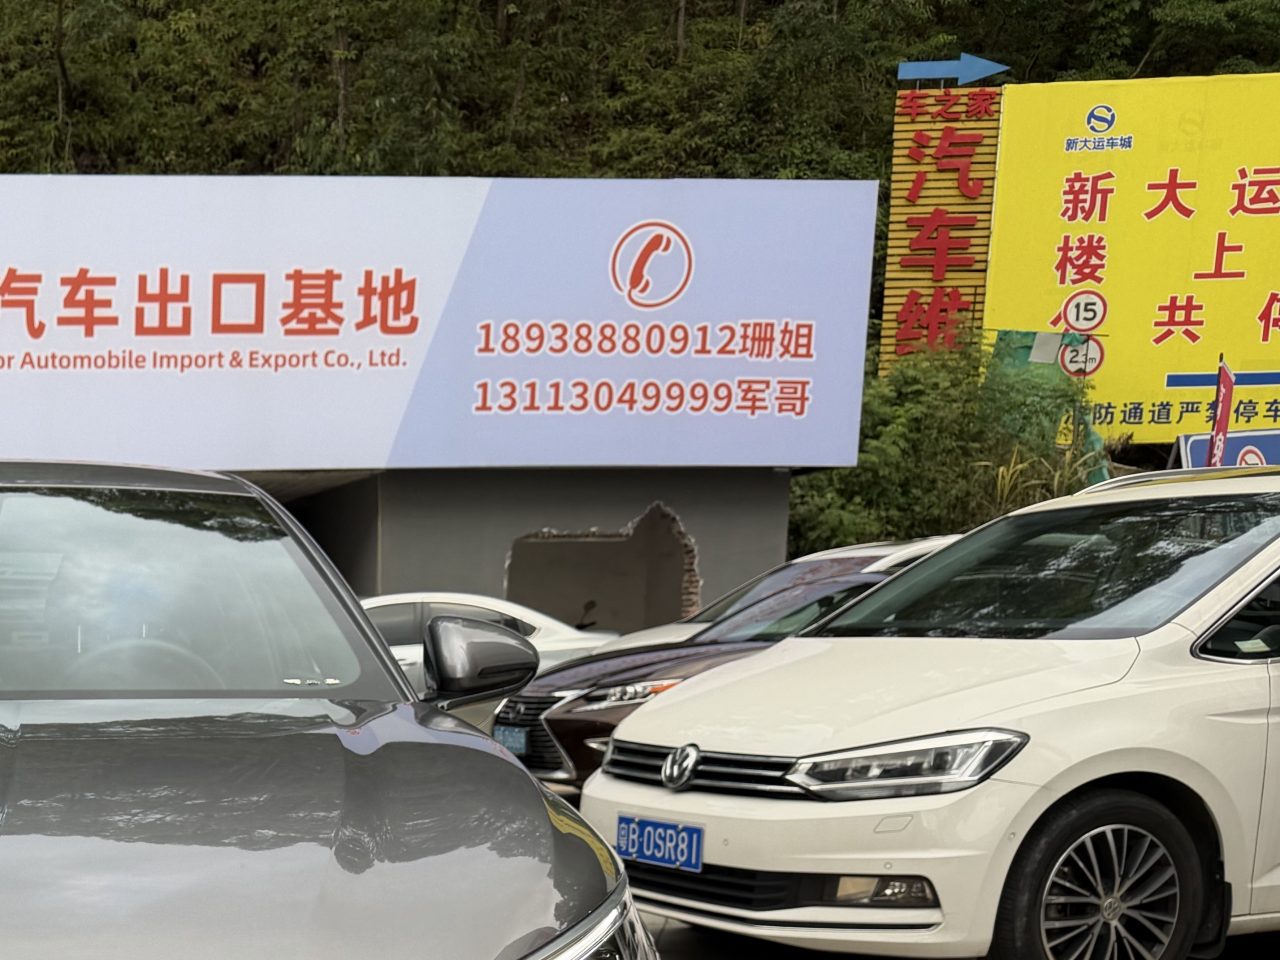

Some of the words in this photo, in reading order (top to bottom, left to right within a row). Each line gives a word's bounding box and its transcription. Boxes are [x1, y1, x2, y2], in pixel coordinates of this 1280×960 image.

[898, 89, 998, 120] 车之家
[1065, 136, 1133, 151] 新大运车城
[896, 126, 985, 356] 汽车维
[1074, 302, 1097, 322] 15
[476, 321, 815, 359] 18938880912珊姐
[20, 349, 147, 370] Automobile
[152, 350, 224, 373] Import
[228, 350, 244, 369] &
[249, 350, 318, 373] Export
[323, 349, 363, 370] Co.,
[368, 348, 408, 368] Ltd.
[474, 378, 811, 416] 13113049999军哥
